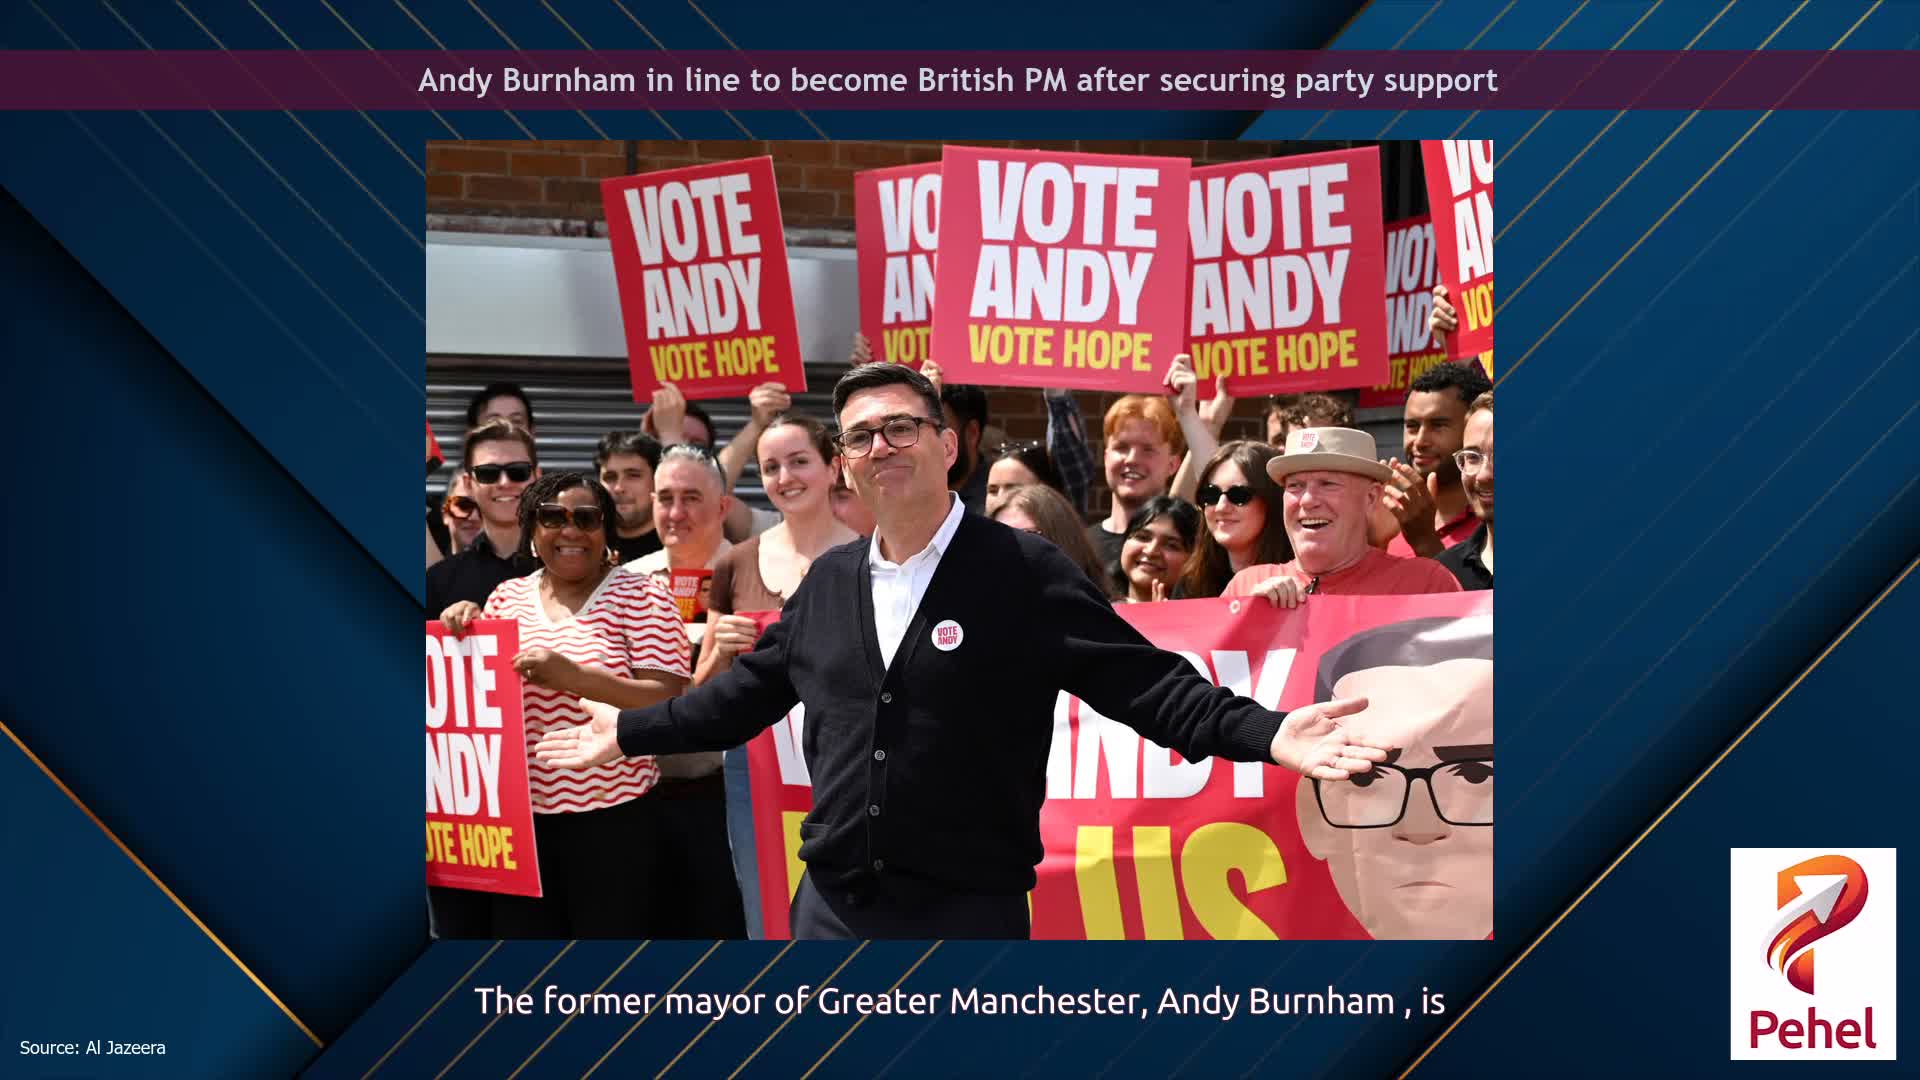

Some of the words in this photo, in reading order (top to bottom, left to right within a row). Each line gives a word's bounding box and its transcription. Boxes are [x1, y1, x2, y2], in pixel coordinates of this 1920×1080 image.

[623, 173, 761, 266] VOTE
[878, 173, 942, 254] VO
[978, 159, 1160, 249] VOTE
[1188, 162, 1353, 259] VOTE
[1453, 190, 1493, 284] AN
[882, 253, 938, 325] AN
[969, 244, 1157, 326] ANDY
[1190, 248, 1352, 338] ANDY
[1385, 223, 1442, 294] VOT
[642, 256, 762, 340] ANDY
[650, 341, 712, 382] VOTE
[713, 335, 780, 377] HOPE
[883, 327, 932, 364] VOT
[968, 324, 1054, 367] VOTE
[1063, 329, 1152, 372] HOPE
[1191, 337, 1269, 380] VOTE
[1276, 329, 1359, 374] HOPE
[673, 575, 700, 587] VOTE
[937, 625, 958, 637] VOTE
[937, 635, 958, 646] ANDY
[426, 634, 503, 730] OTE
[426, 732, 502, 818] NDY
[459, 823, 518, 871] HOPE
